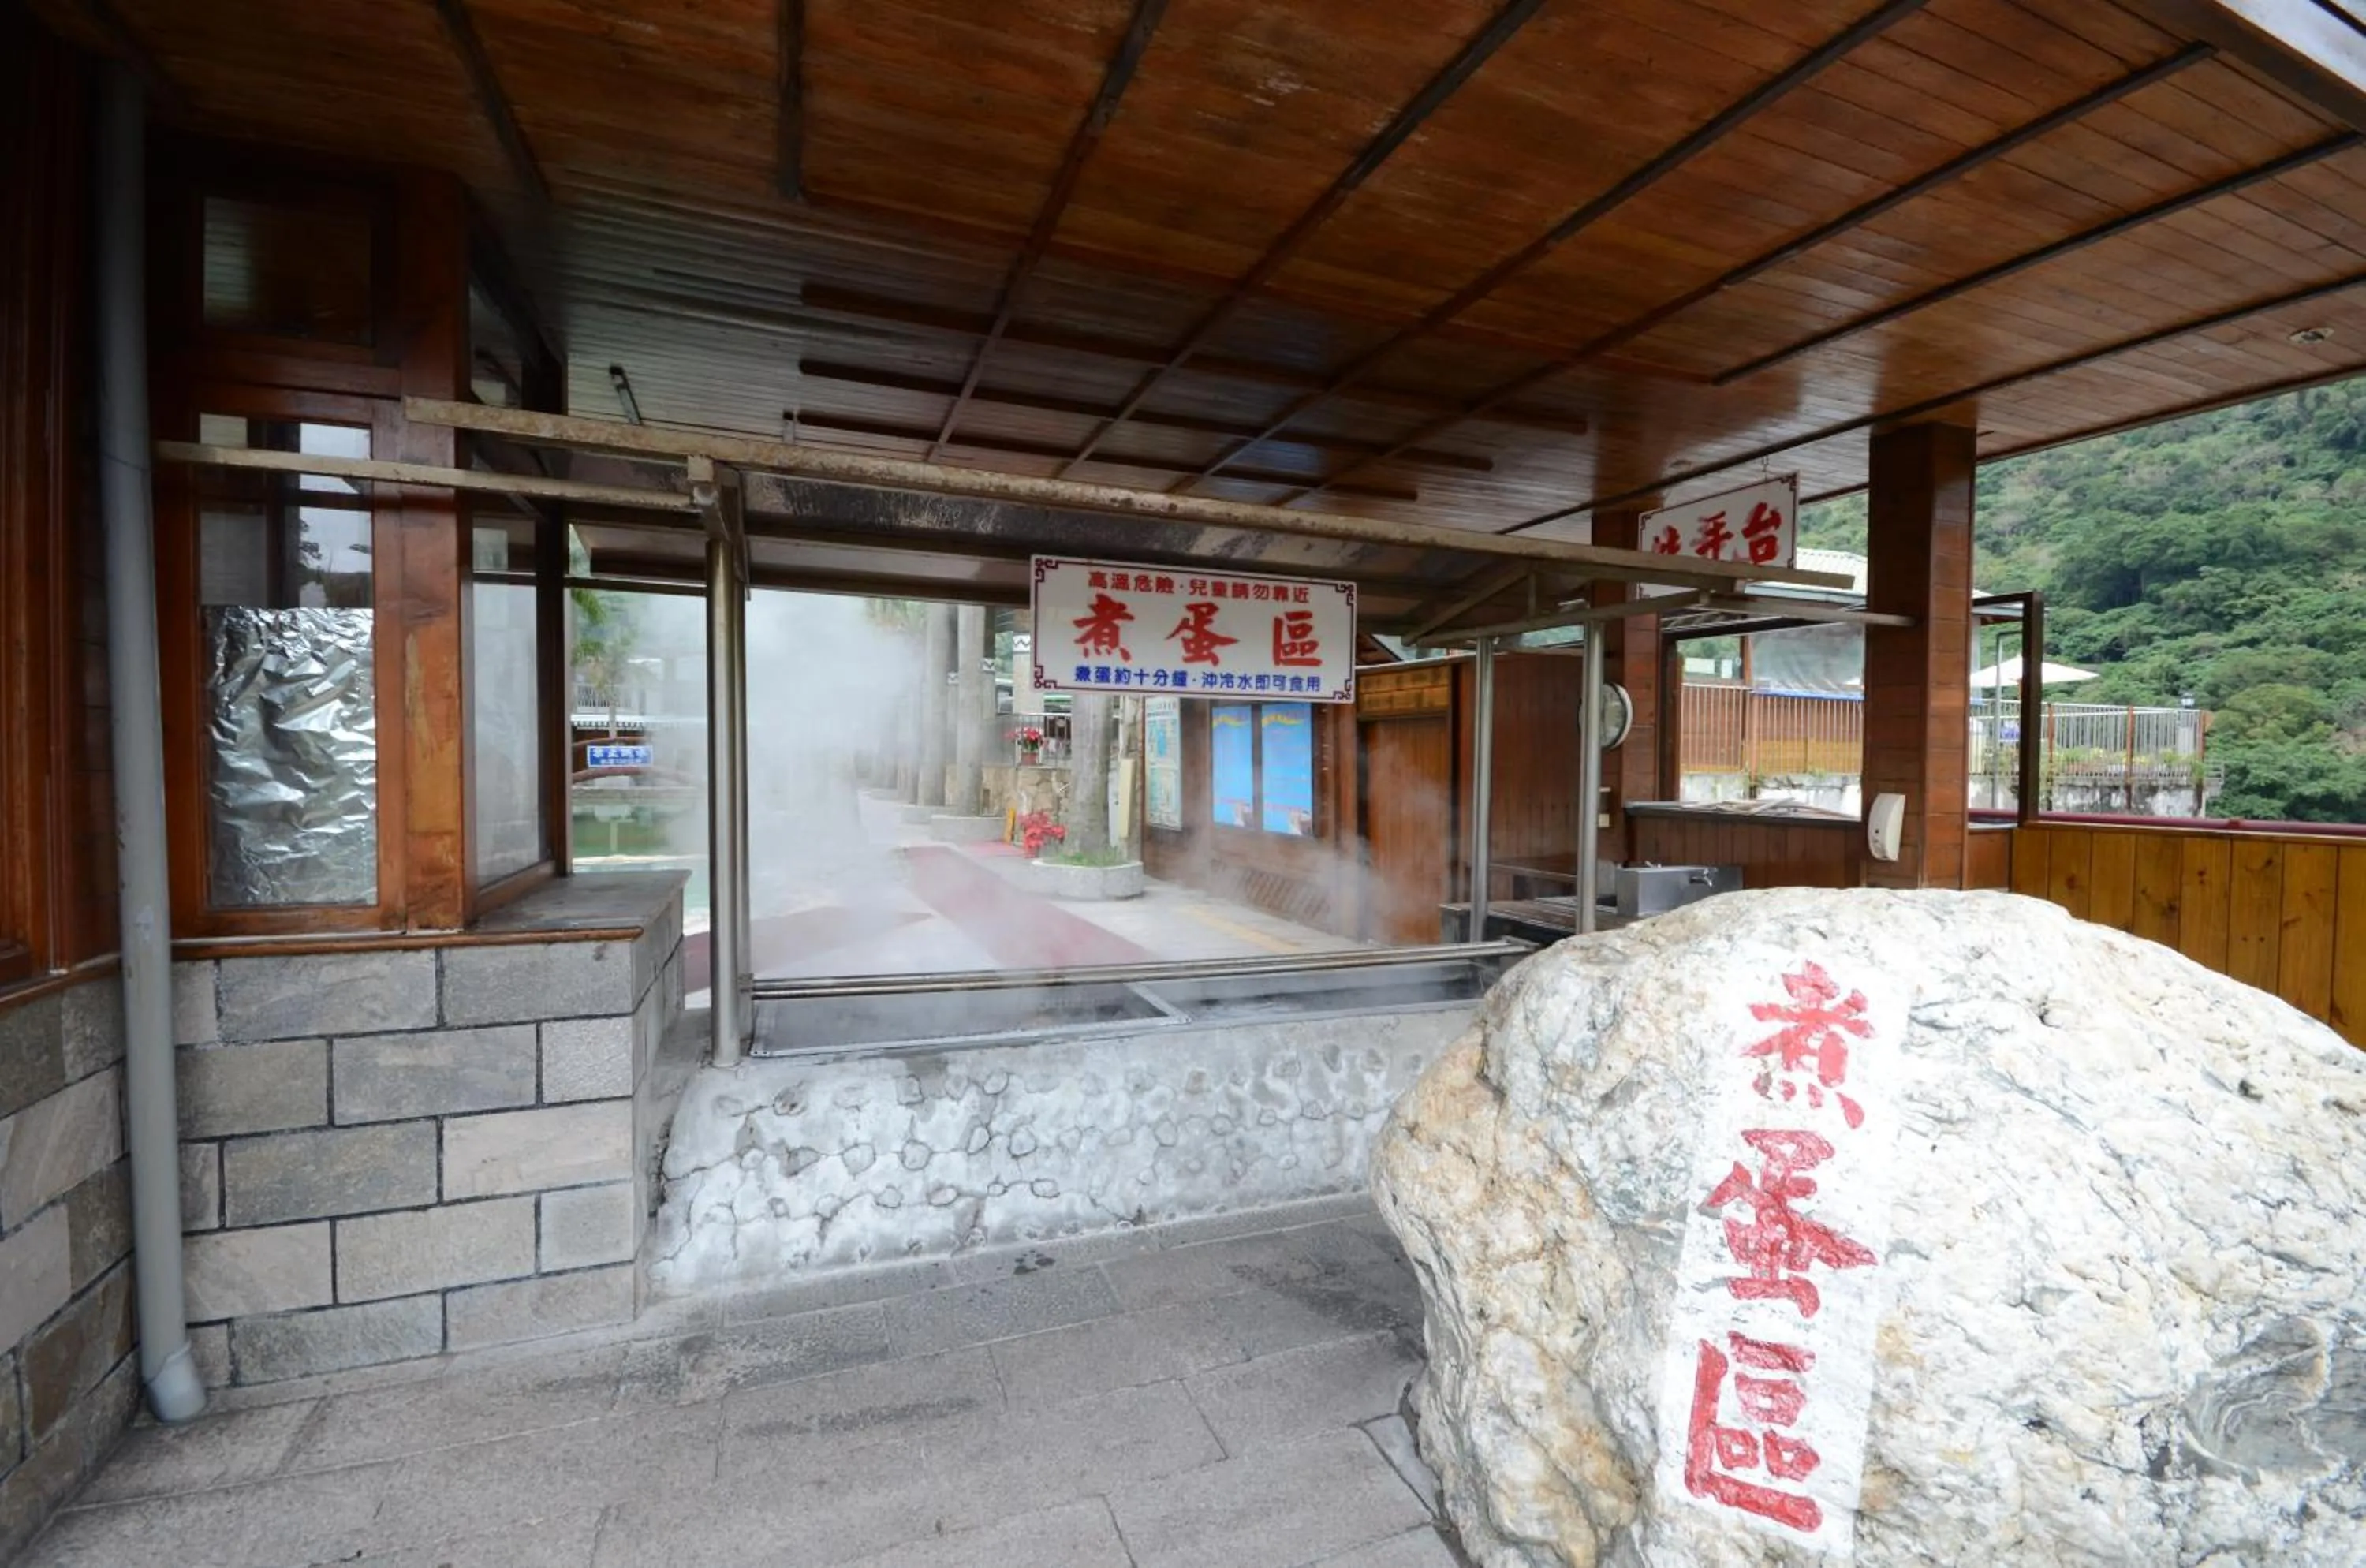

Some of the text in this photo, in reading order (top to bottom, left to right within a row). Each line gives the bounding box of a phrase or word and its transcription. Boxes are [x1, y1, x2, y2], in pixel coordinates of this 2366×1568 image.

[1073, 593, 1323, 667] 煮蛋區
[1684, 959, 1877, 1533] 煮蛋區
